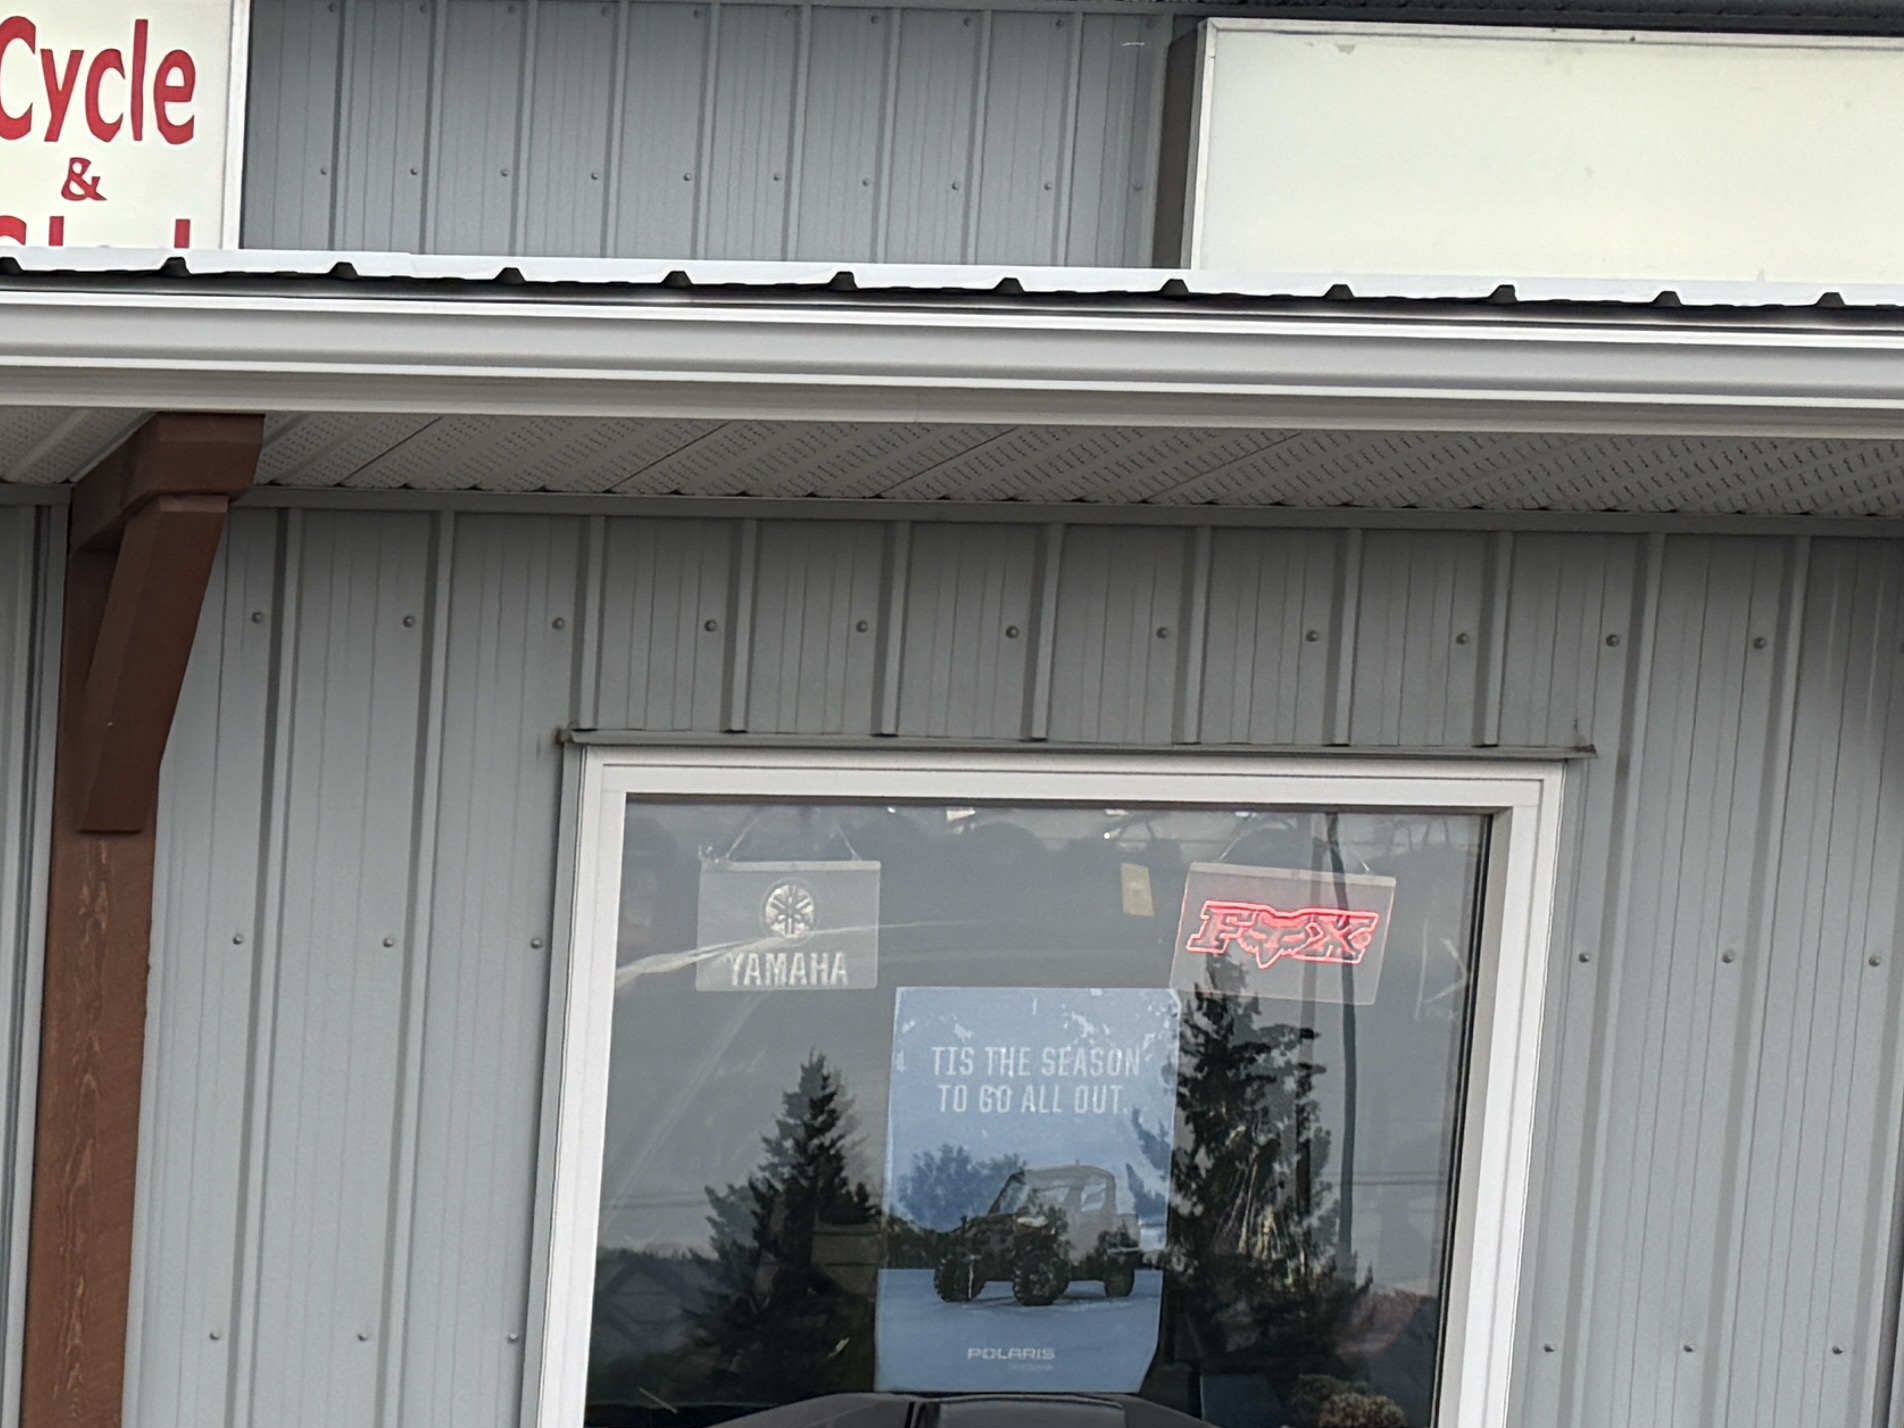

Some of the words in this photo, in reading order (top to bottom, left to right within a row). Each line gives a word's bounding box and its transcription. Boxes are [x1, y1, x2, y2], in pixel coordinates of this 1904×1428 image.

[60, 157, 108, 201] &
[725, 951, 849, 987] YAMAHA
[984, 1047, 1031, 1077] THE
[1042, 1046, 1140, 1077] SEASON
[938, 1084, 966, 1113] TO
[979, 1086, 1012, 1114] GO
[1021, 1084, 1063, 1114] ALL
[967, 1347, 1056, 1360] POLARIS
